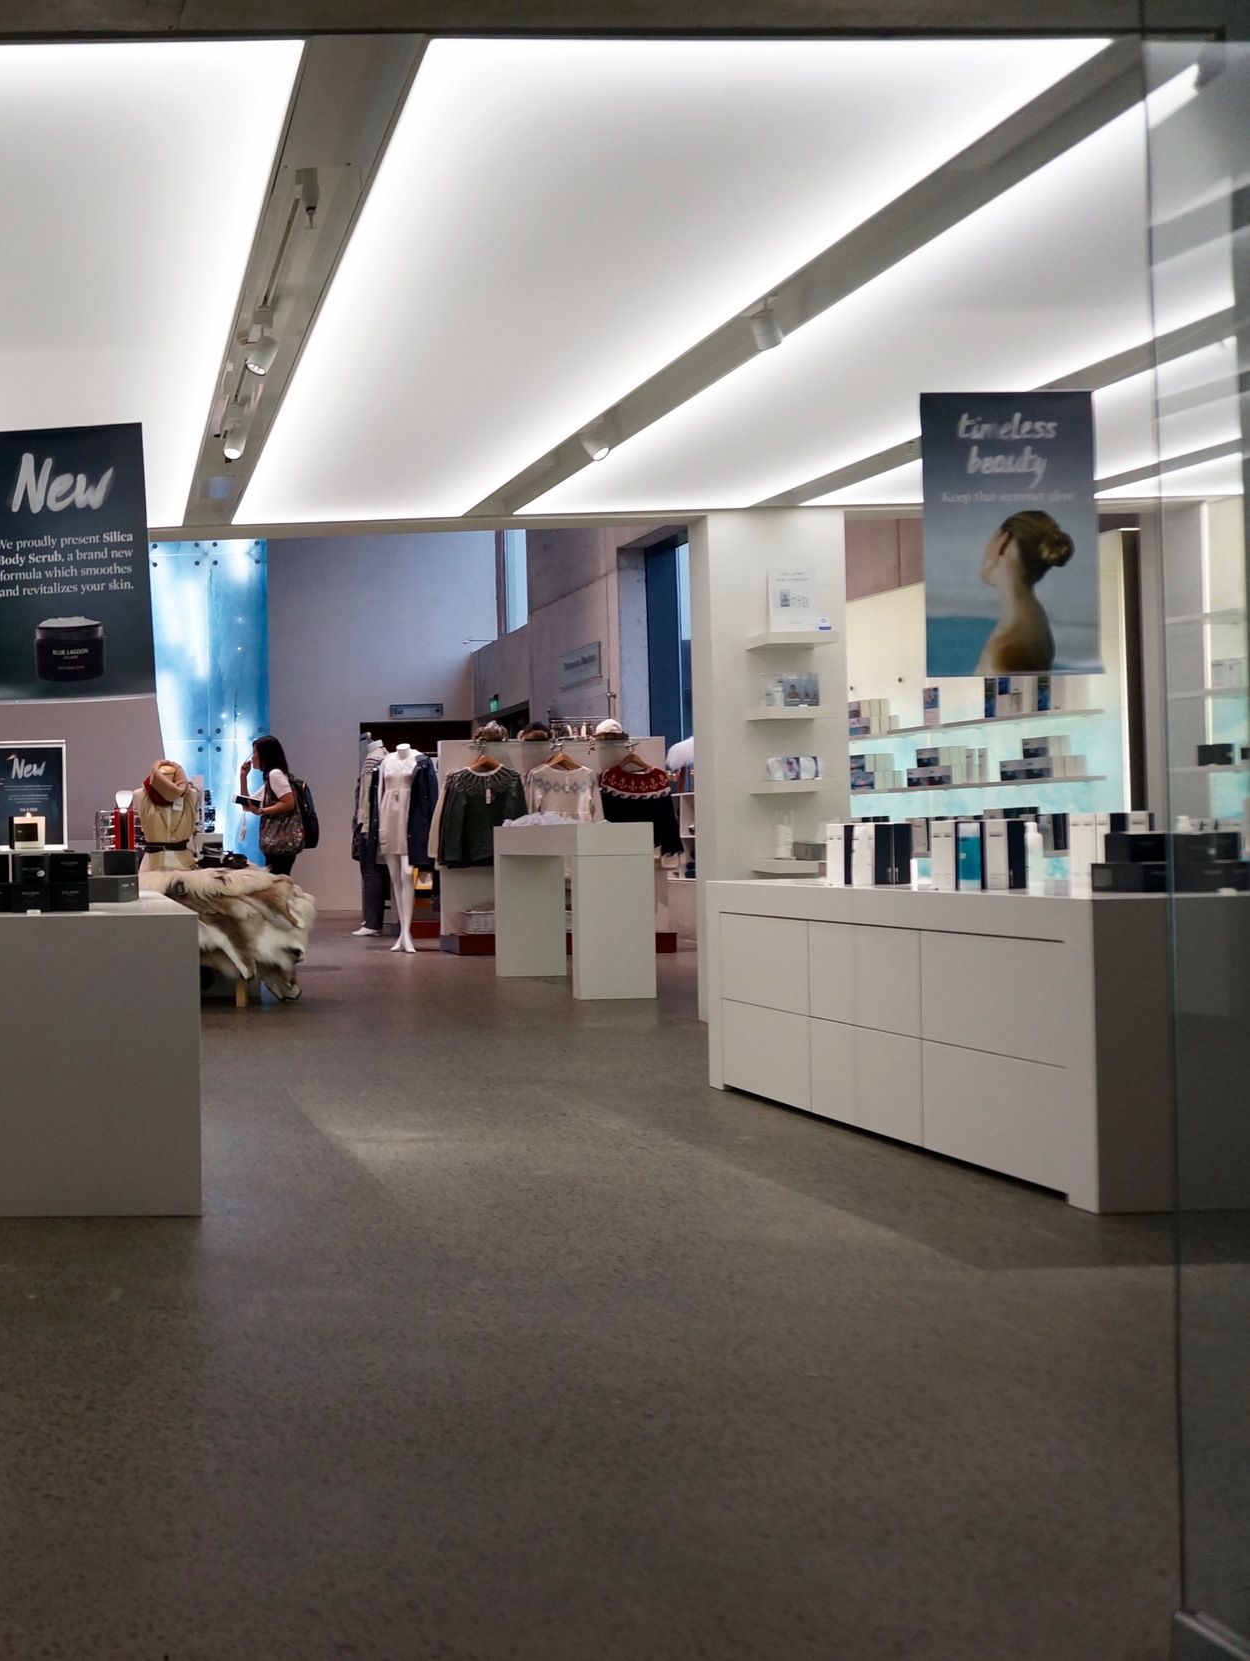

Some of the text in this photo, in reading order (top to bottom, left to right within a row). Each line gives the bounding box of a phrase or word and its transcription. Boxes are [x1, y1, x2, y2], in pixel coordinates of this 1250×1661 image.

[967, 445, 1048, 489] beauty
[11, 452, 115, 514] New
[16, 535, 58, 551] proudly
[60, 534, 100, 548] present
[102, 531, 134, 543] Silica
[67, 552, 73, 562] a
[76, 547, 109, 561] brand
[111, 548, 134, 558] new
[0, 562, 132, 581] formula which smoothes
[0, 579, 134, 598] and revitalizes your skin.
[11, 757, 46, 779] New
